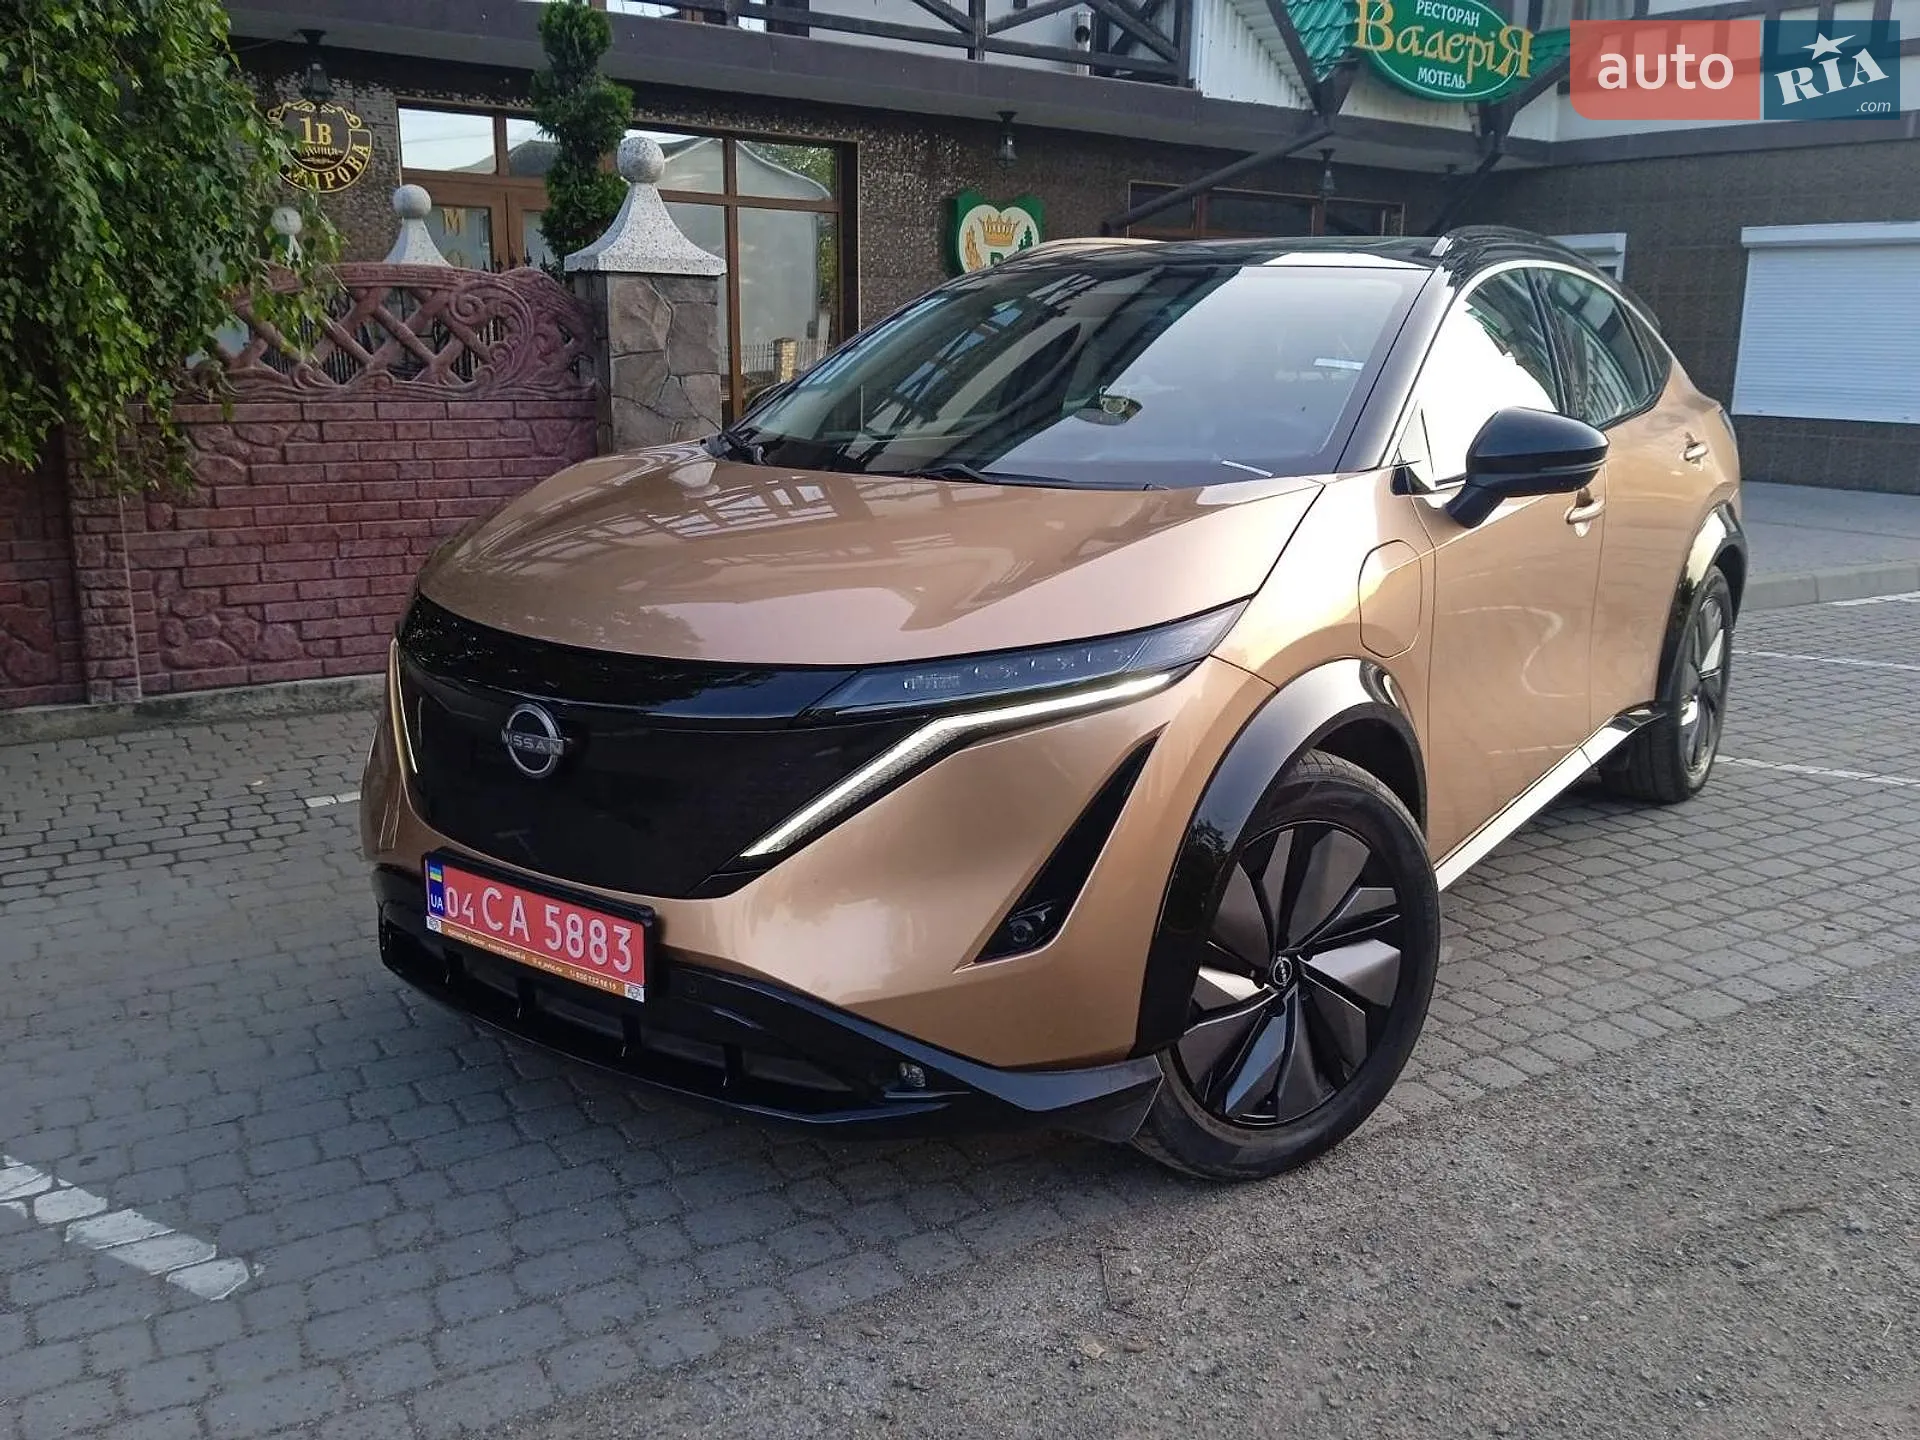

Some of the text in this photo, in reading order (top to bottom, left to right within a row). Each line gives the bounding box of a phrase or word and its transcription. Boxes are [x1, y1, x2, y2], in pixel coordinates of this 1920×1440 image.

[1416, 1, 1480, 27] РЕСТОРАН
[1417, 67, 1466, 89] МОТЕЛЬ
[501, 728, 564, 756] NISSAN
[431, 896, 443, 911] UA
[545, 904, 632, 974] 5883
